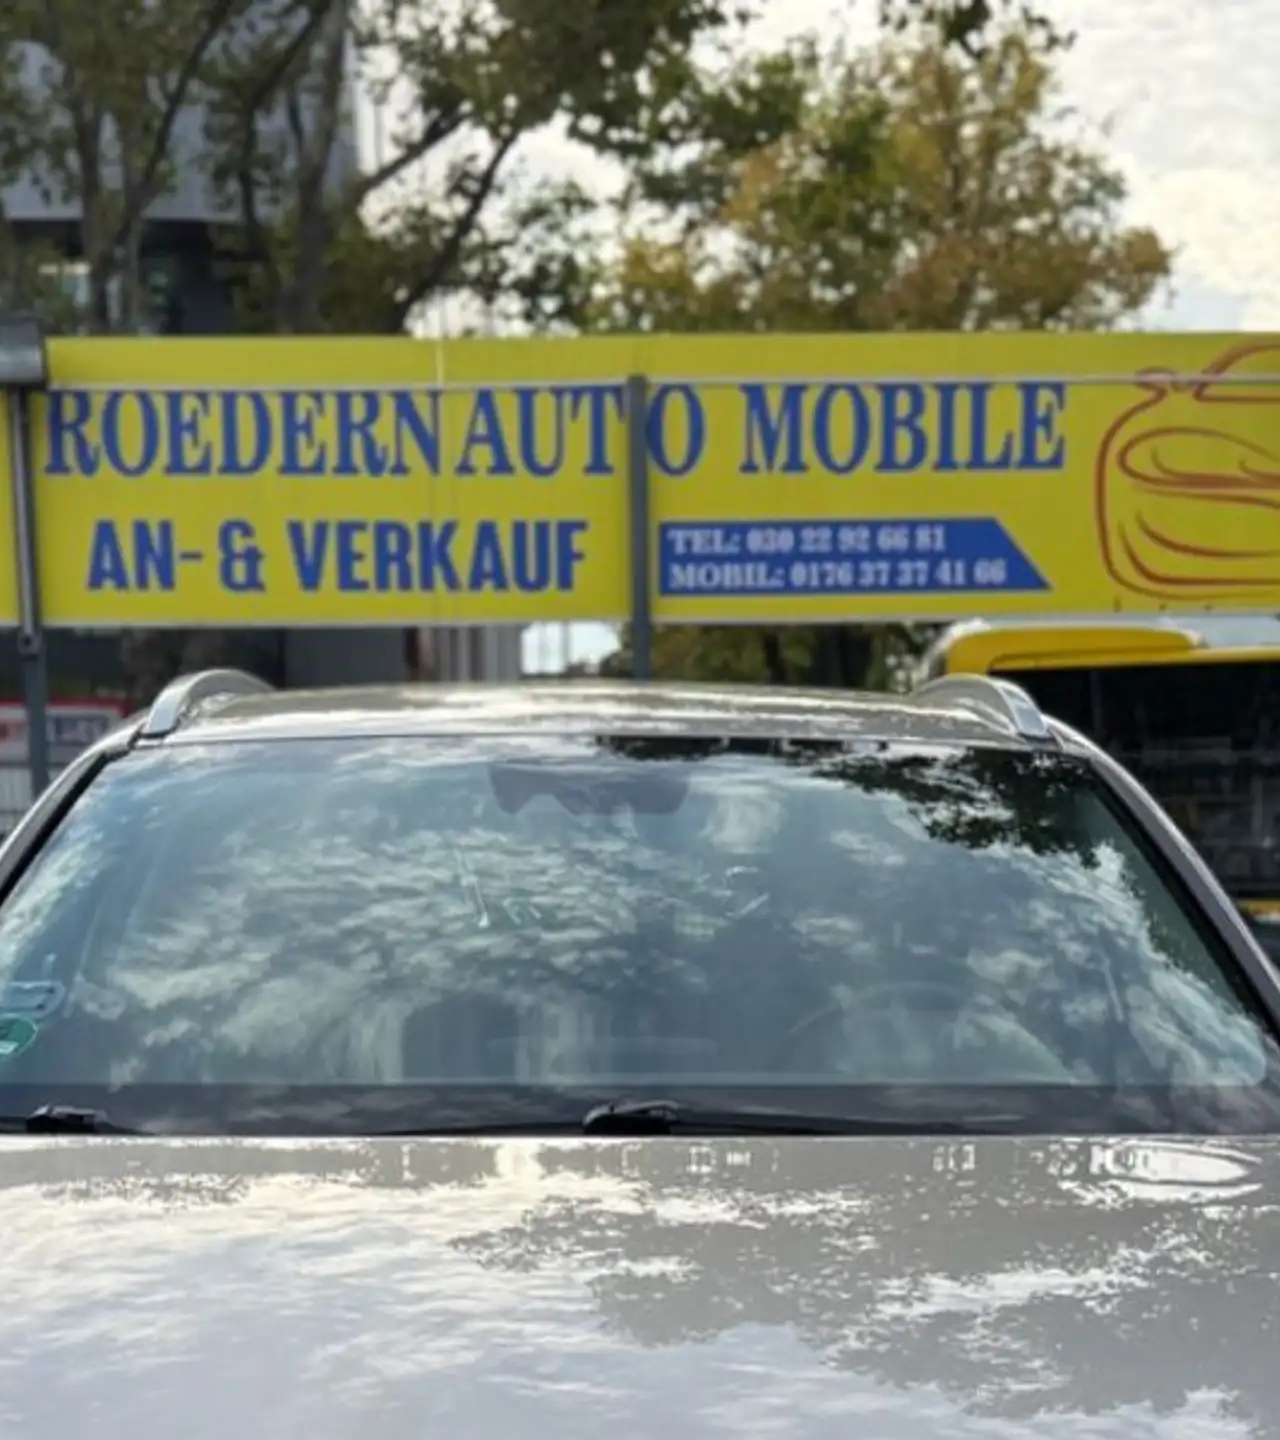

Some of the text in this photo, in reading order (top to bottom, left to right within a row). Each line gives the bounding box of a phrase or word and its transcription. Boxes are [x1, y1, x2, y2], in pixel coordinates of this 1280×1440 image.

[218, 520, 266, 592] &
[286, 520, 589, 592] VERKAUF
[667, 528, 741, 555] TEL:
[746, 527, 794, 555] 030
[669, 562, 784, 590] MOBIL:
[788, 561, 854, 589] 0176
[858, 560, 891, 588] 37
[896, 560, 929, 588] 37
[933, 559, 966, 587] 41
